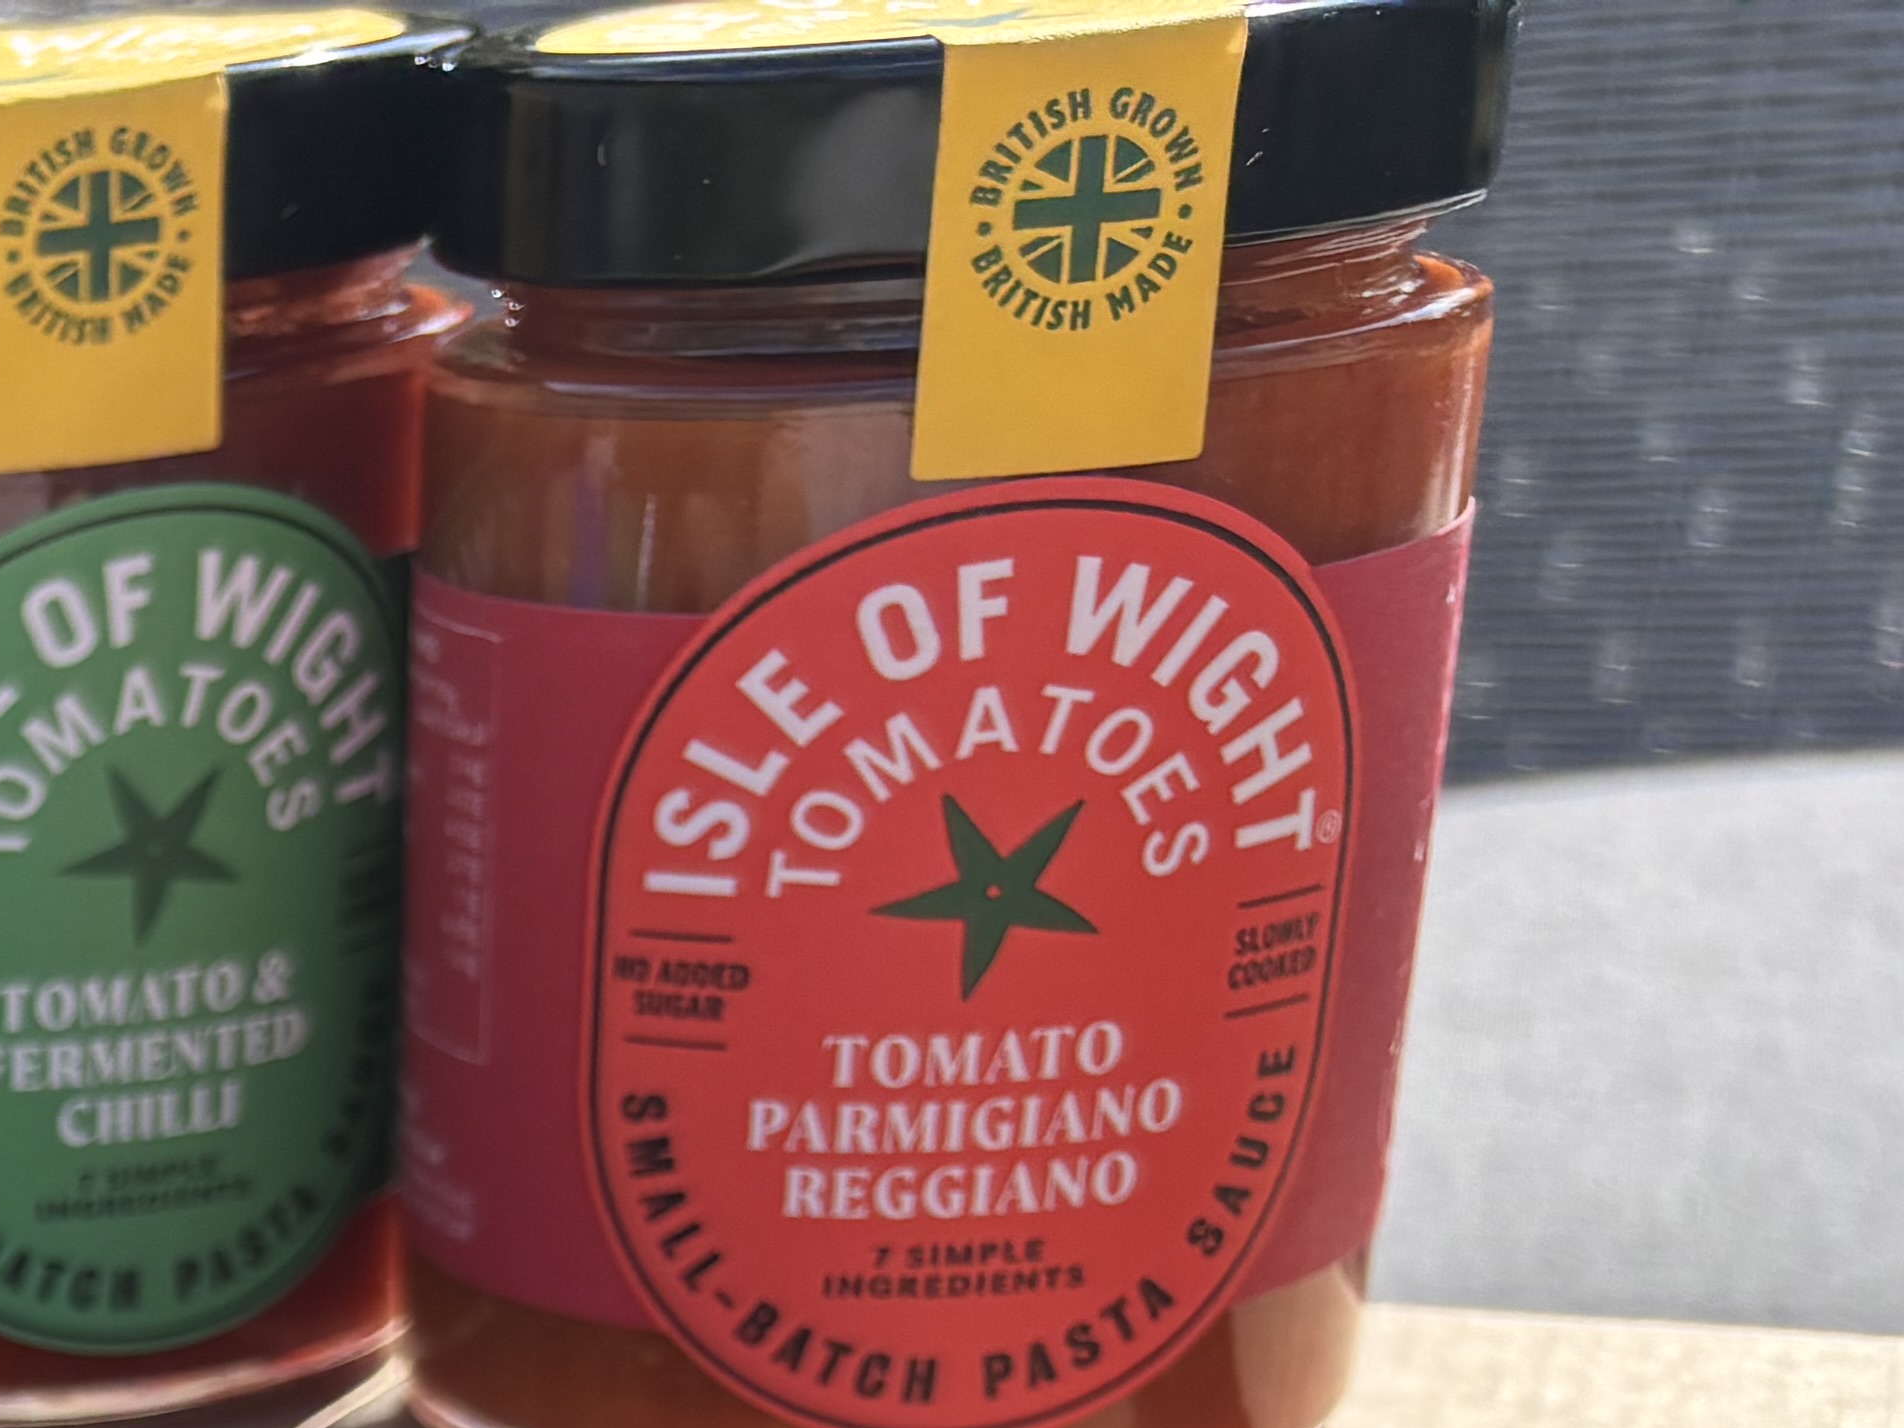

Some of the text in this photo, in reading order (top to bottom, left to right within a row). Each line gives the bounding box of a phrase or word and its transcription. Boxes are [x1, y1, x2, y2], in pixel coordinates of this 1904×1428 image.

[970, 87, 1202, 207] BRITISH GROWN
[971, 231, 1192, 331] BRITISH MADE
[21, 553, 154, 668] OF
[196, 548, 390, 807] WIGHT
[643, 649, 845, 897] ISLE
[857, 558, 1013, 681] OF
[1066, 555, 1316, 851] WIGHT
[766, 683, 1209, 897] TOMATOES
[1228, 946, 1315, 990] COOKED
[1236, 912, 1319, 956] SLOWLY
[253, 950, 291, 1002] &
[614, 956, 750, 991] NO ADDED
[635, 991, 724, 1020] SUGAR
[822, 1020, 1123, 1088] TOMATO
[56, 1078, 243, 1148] CHILLI
[746, 1077, 1182, 1153] PARMIGIANO
[781, 1151, 1138, 1220] REGGIANO
[621, 1092, 936, 1402] SMALL-BATCH
[983, 1275, 1175, 1397] PASTA
[1188, 1045, 1296, 1258] SAUCE
[872, 1239, 1045, 1267] 7 SIMPLE
[821, 1266, 1085, 1299] INGREDIENTS
